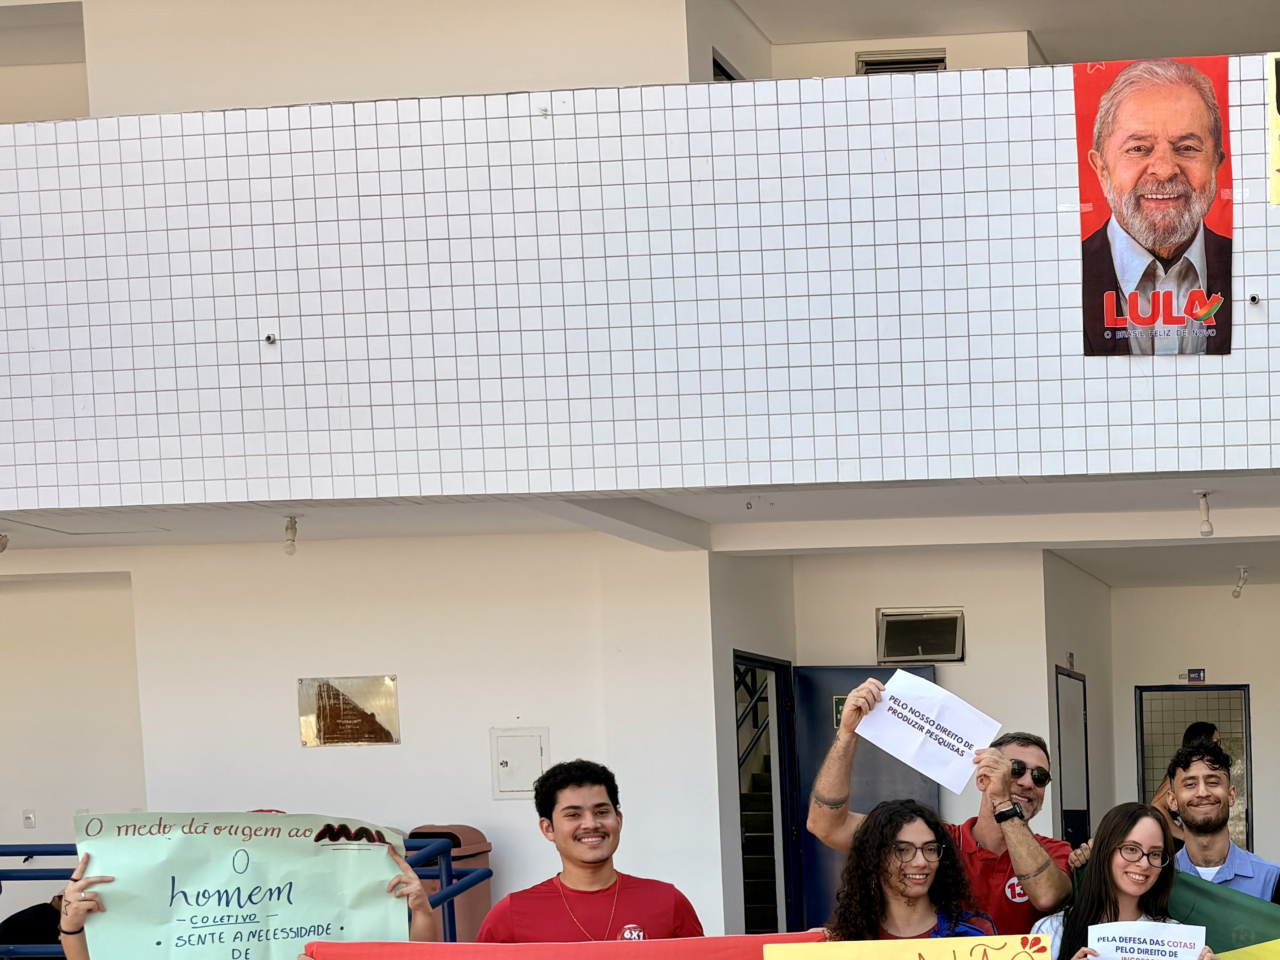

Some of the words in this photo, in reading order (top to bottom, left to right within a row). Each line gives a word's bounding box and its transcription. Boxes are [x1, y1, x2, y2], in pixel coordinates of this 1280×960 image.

[1104, 288, 1223, 327] LULA
[1104, 330, 1112, 339] O
[1116, 329, 1144, 339] BRASIL
[1149, 329, 1171, 337] FELIZ
[1176, 329, 1187, 337] DE
[1192, 328, 1217, 337] NOVO
[887, 706, 925, 733] PRODUZIR
[925, 729, 966, 757] PESQUISAS
[888, 694, 908, 711] PELO
[908, 706, 936, 727] NOSSO
[935, 723, 964, 744] DIREITO
[963, 740, 975, 751] DE
[85, 818, 103, 838] O
[117, 817, 177, 838] medo
[213, 825, 282, 842] origem
[288, 826, 313, 839] ao
[232, 849, 249, 874] O
[169, 875, 294, 909] homem
[1008, 882, 1028, 900] 13
[175, 931, 226, 948] SENTE
[232, 931, 245, 943] A
[247, 924, 332, 943] NECESSIDADE
[1118, 936, 1148, 946] DEFESA
[1149, 938, 1165, 947] DAS
[1167, 940, 1196, 949] COTAS!
[232, 948, 251, 960] DE
[1115, 946, 1136, 954] PELO
[1137, 947, 1167, 957] DIREITO
[1169, 950, 1178, 958] DE
